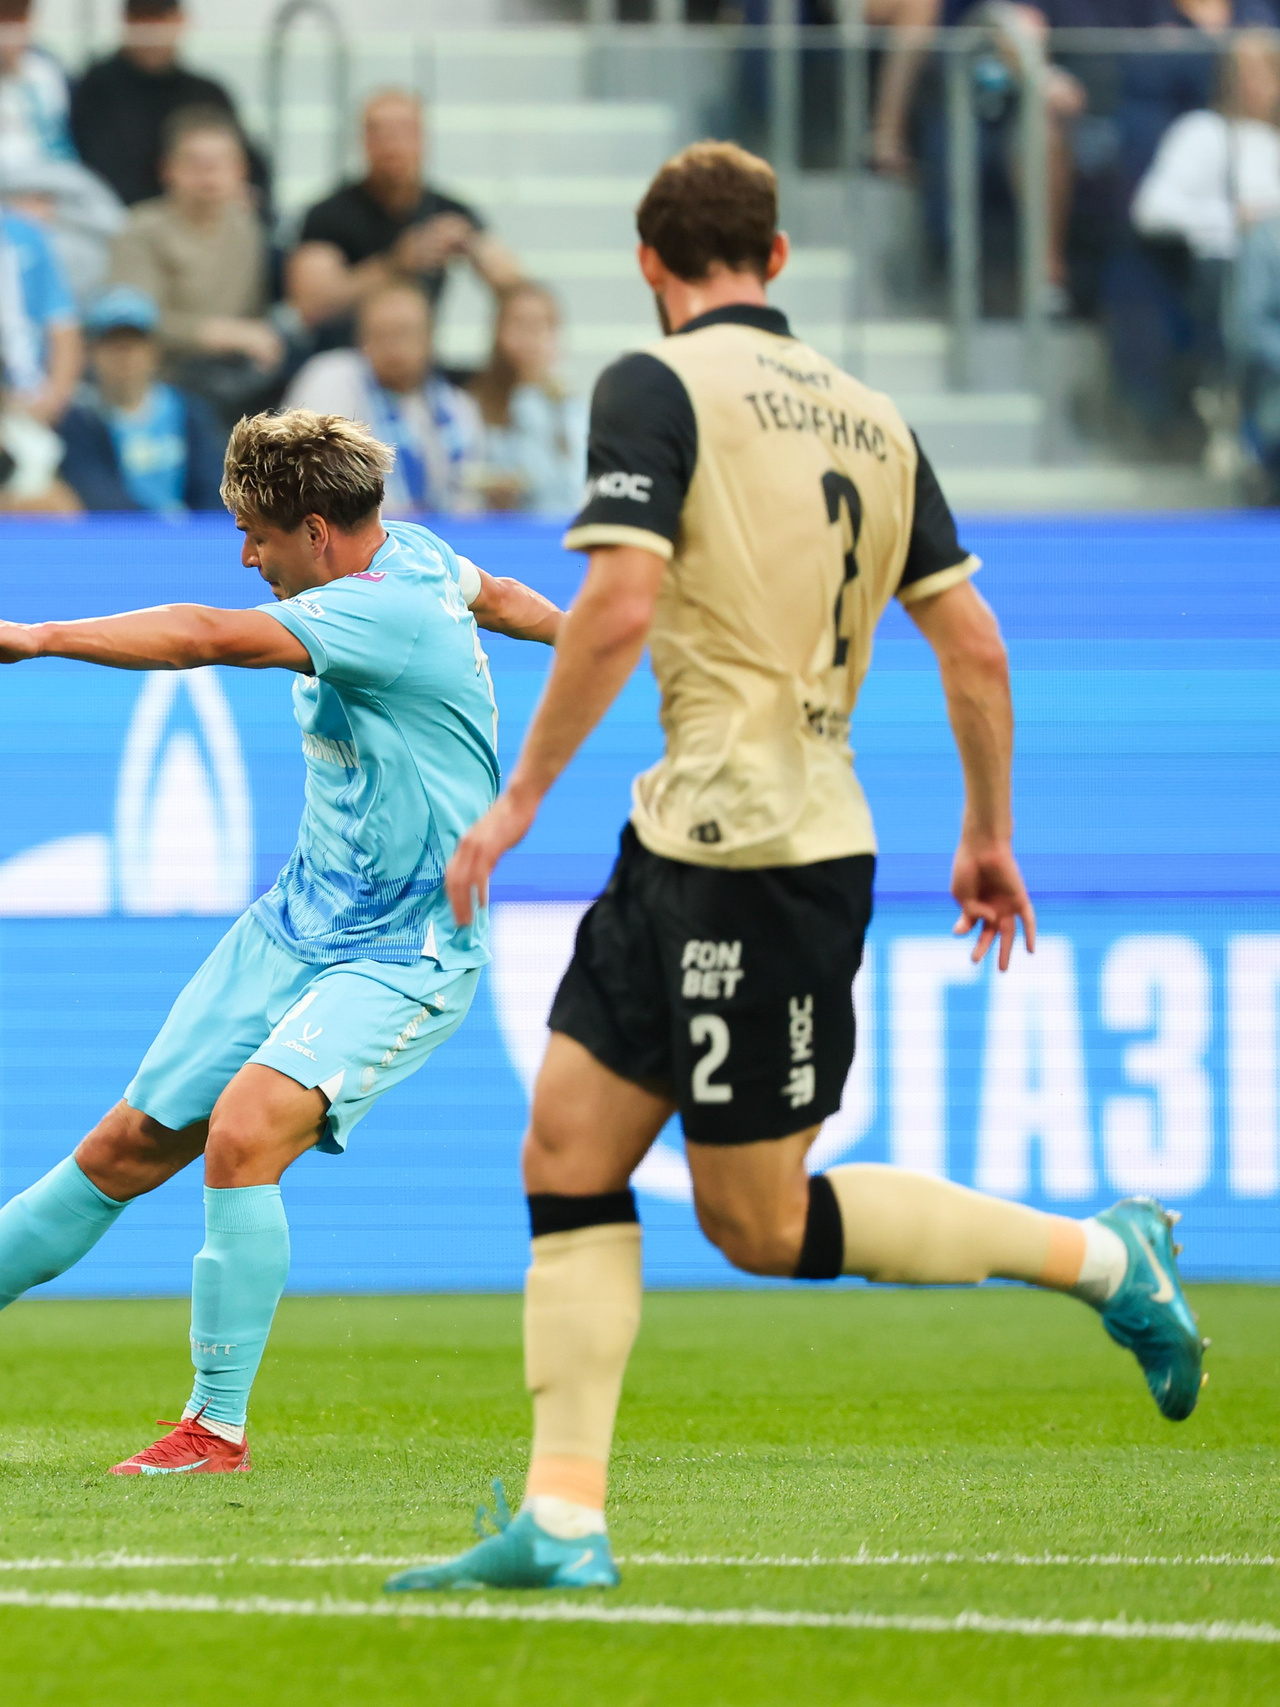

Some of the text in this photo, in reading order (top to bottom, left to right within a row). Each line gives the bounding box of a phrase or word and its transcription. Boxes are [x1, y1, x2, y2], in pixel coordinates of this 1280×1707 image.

[820, 469, 863, 668] 2
[681, 939, 743, 970] FON
[681, 968, 745, 999] BET
[689, 1013, 733, 1104] 2
